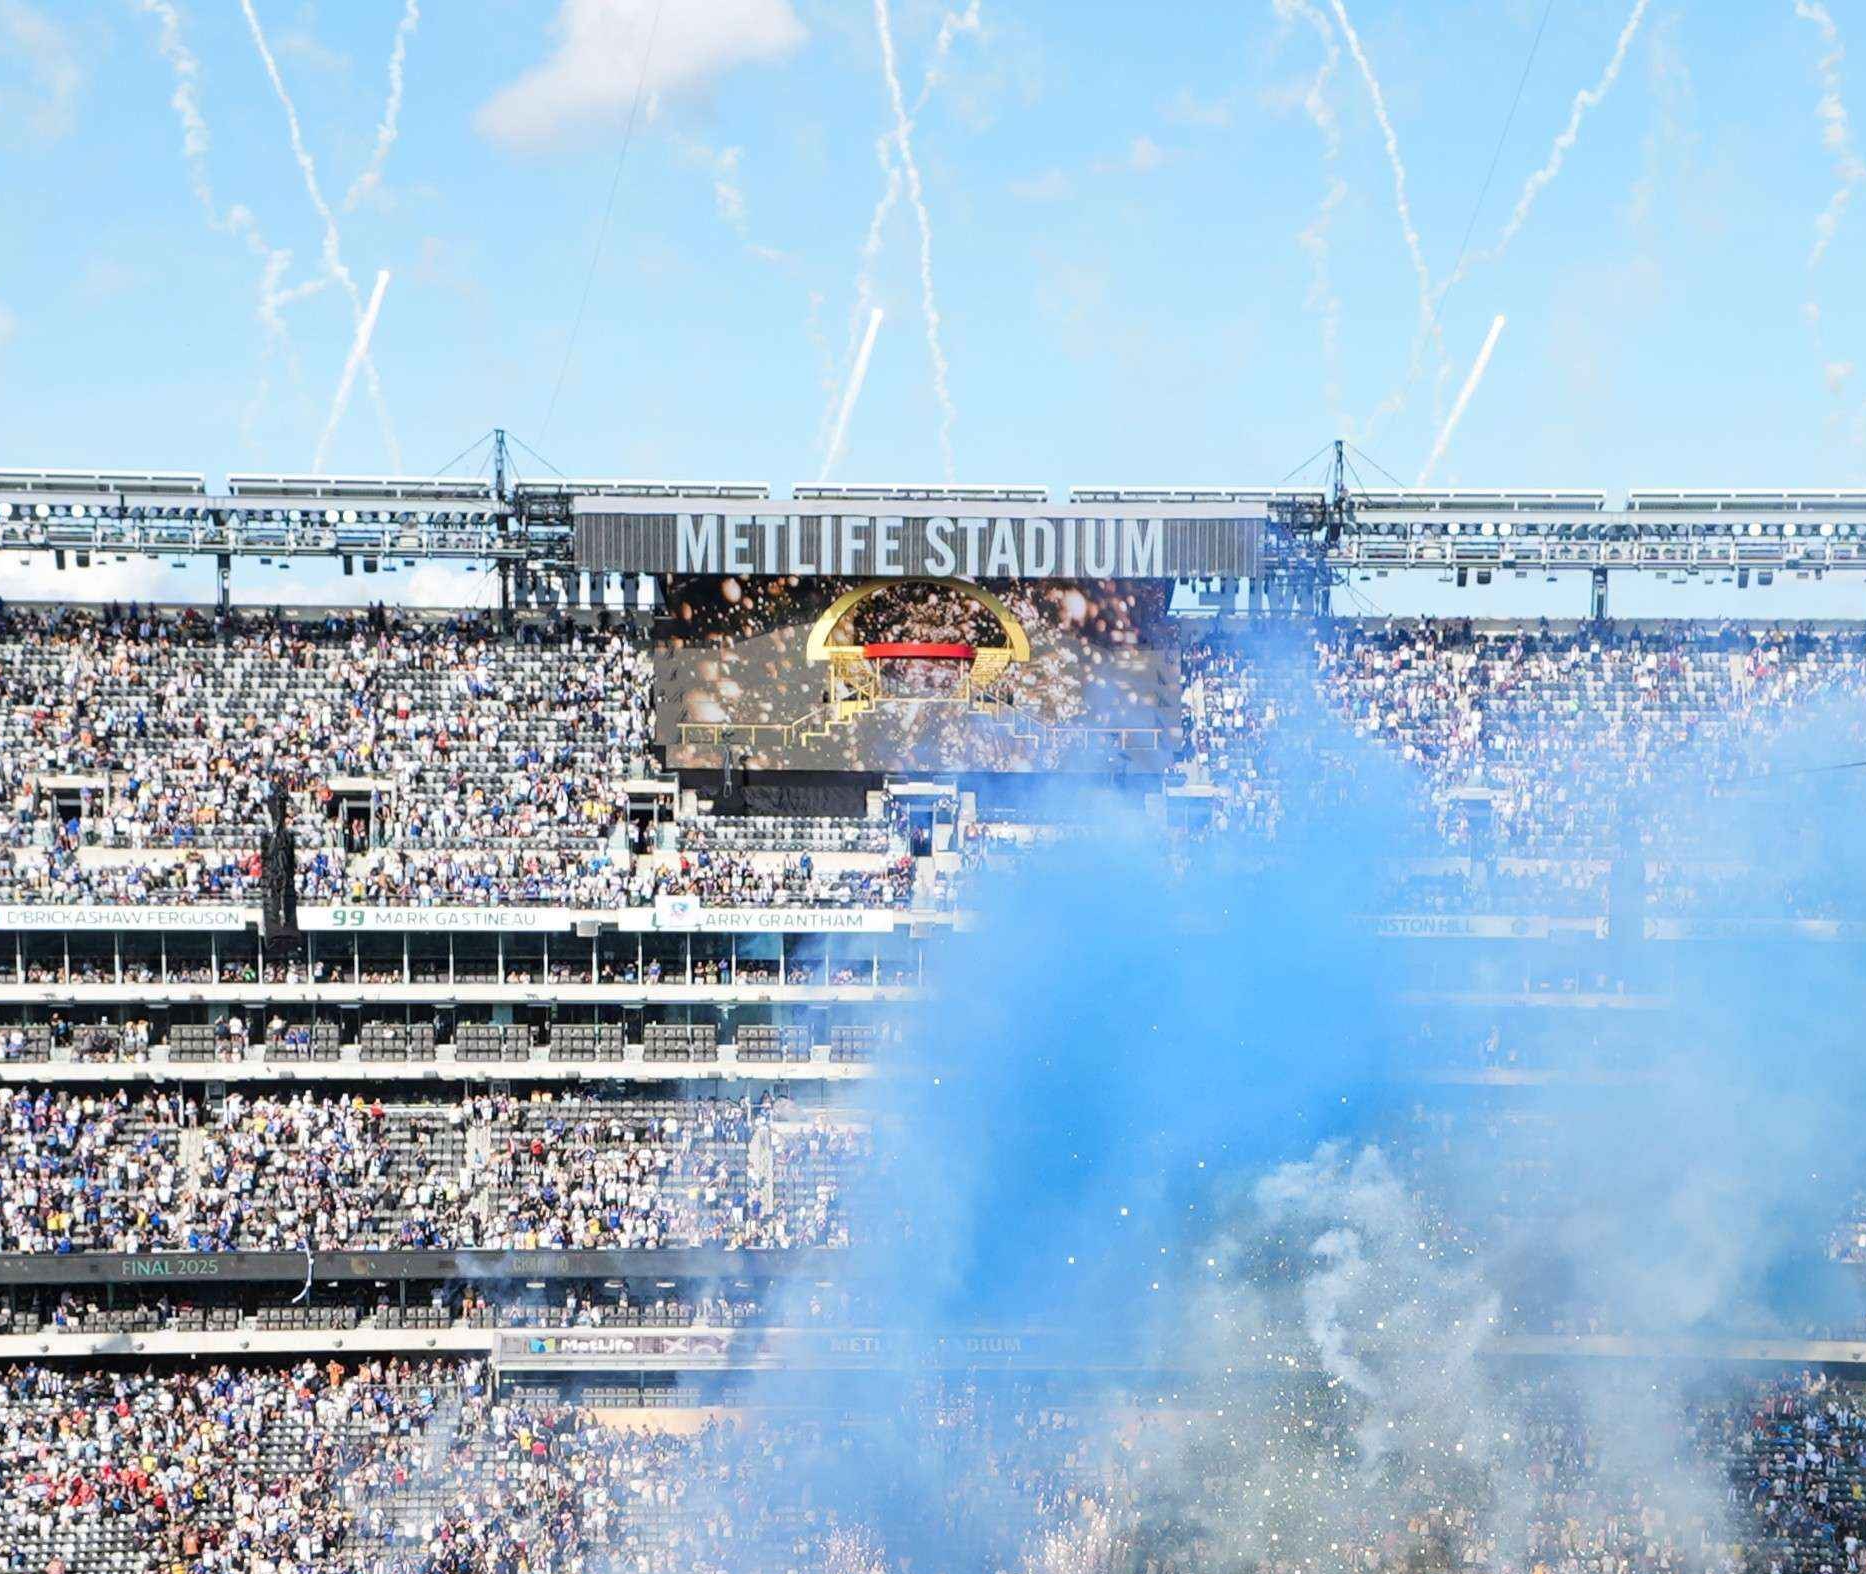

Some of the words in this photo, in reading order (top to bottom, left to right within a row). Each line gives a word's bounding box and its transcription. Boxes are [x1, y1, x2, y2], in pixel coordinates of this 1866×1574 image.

[677, 514, 903, 575] METLIFE
[925, 515, 1162, 577] STADIUM
[147, 910, 240, 926] FERGUSON
[332, 909, 365, 927] 99
[375, 911, 430, 926] MARK
[435, 911, 537, 926] GASTINEAU
[705, 914, 754, 928] ARRY
[758, 914, 863, 928] GRANTHAM
[122, 1260, 174, 1276] FINAL
[177, 1259, 219, 1275] 2025
[559, 1337, 634, 1352] MetLife
